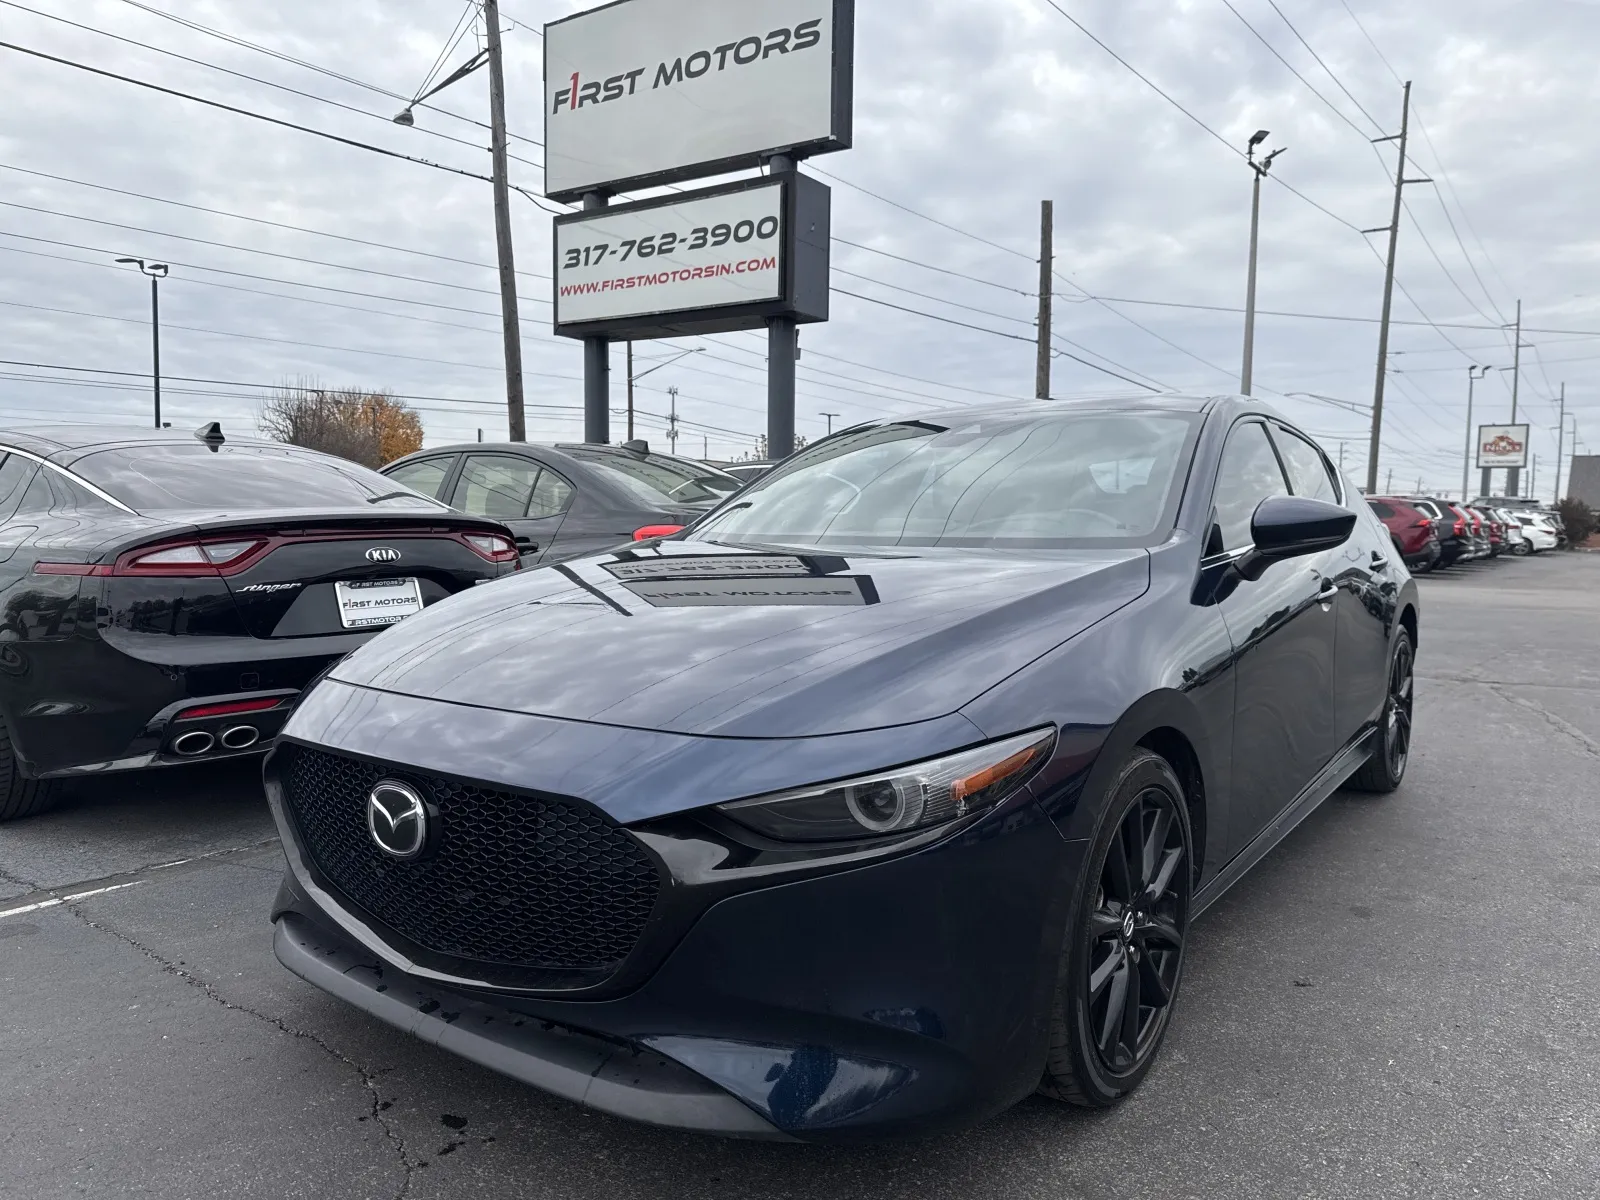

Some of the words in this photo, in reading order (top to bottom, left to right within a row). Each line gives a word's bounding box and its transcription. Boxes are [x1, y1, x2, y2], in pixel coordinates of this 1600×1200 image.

[652, 18, 823, 89] MOTORS
[563, 215, 778, 269] 317-762-3900
[560, 256, 776, 297] WWW.FIRSTMOTORSIN.COM
[372, 550, 397, 561] KIA
[375, 596, 418, 606] MOTORS
